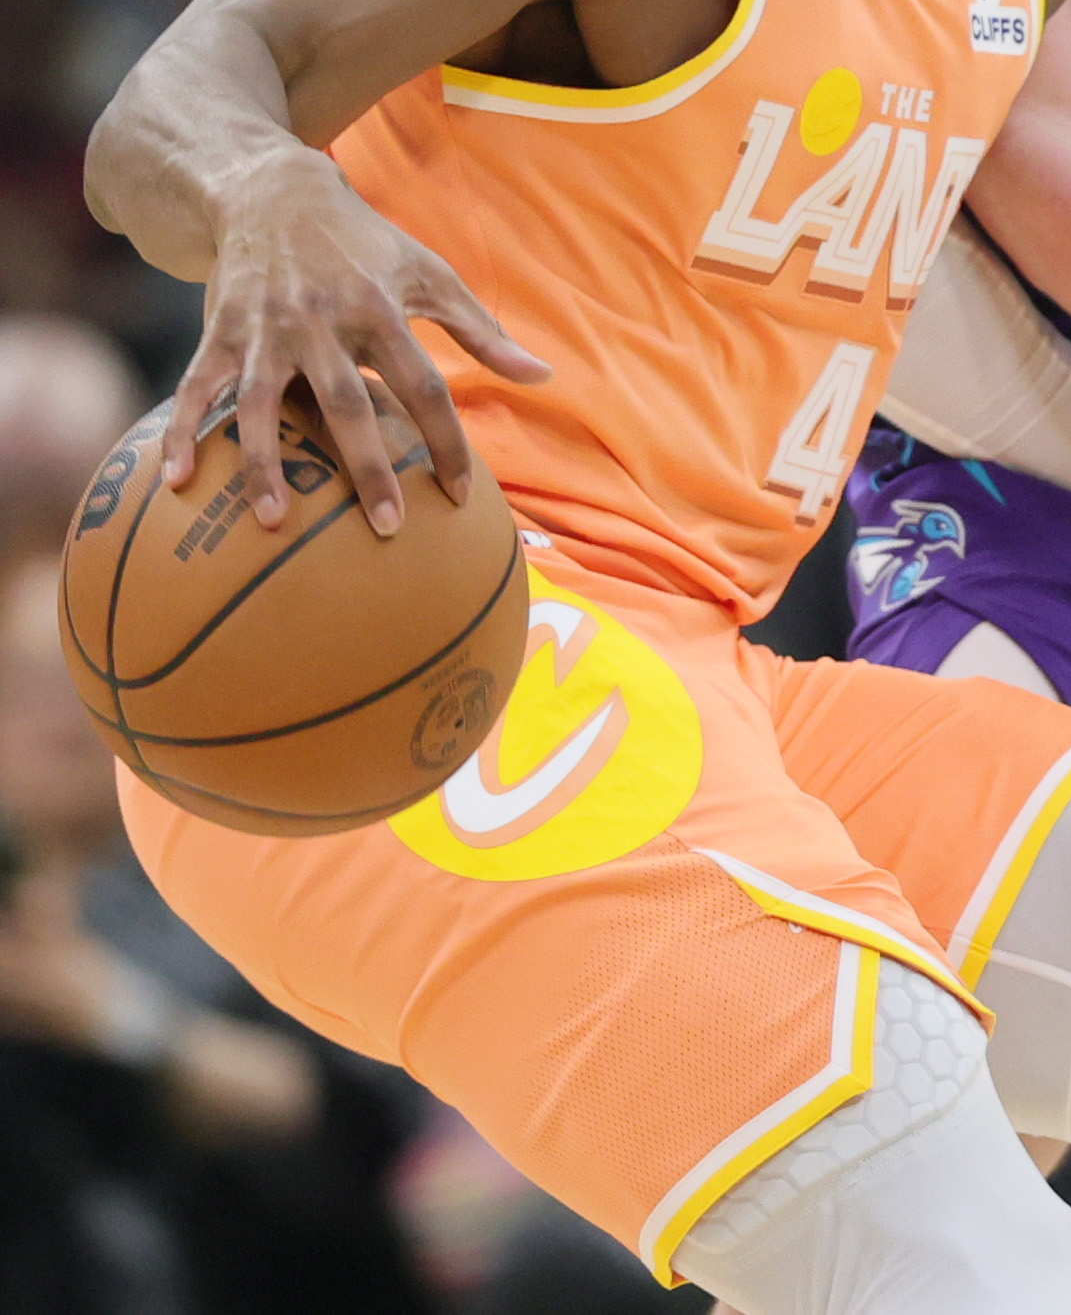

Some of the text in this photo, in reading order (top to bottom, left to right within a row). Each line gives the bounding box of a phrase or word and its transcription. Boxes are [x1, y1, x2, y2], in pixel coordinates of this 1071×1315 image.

[971, 13, 1025, 45] CLIFFS
[880, 82, 935, 123] THE
[690, 99, 987, 311] LAN
[764, 340, 876, 528] 4
